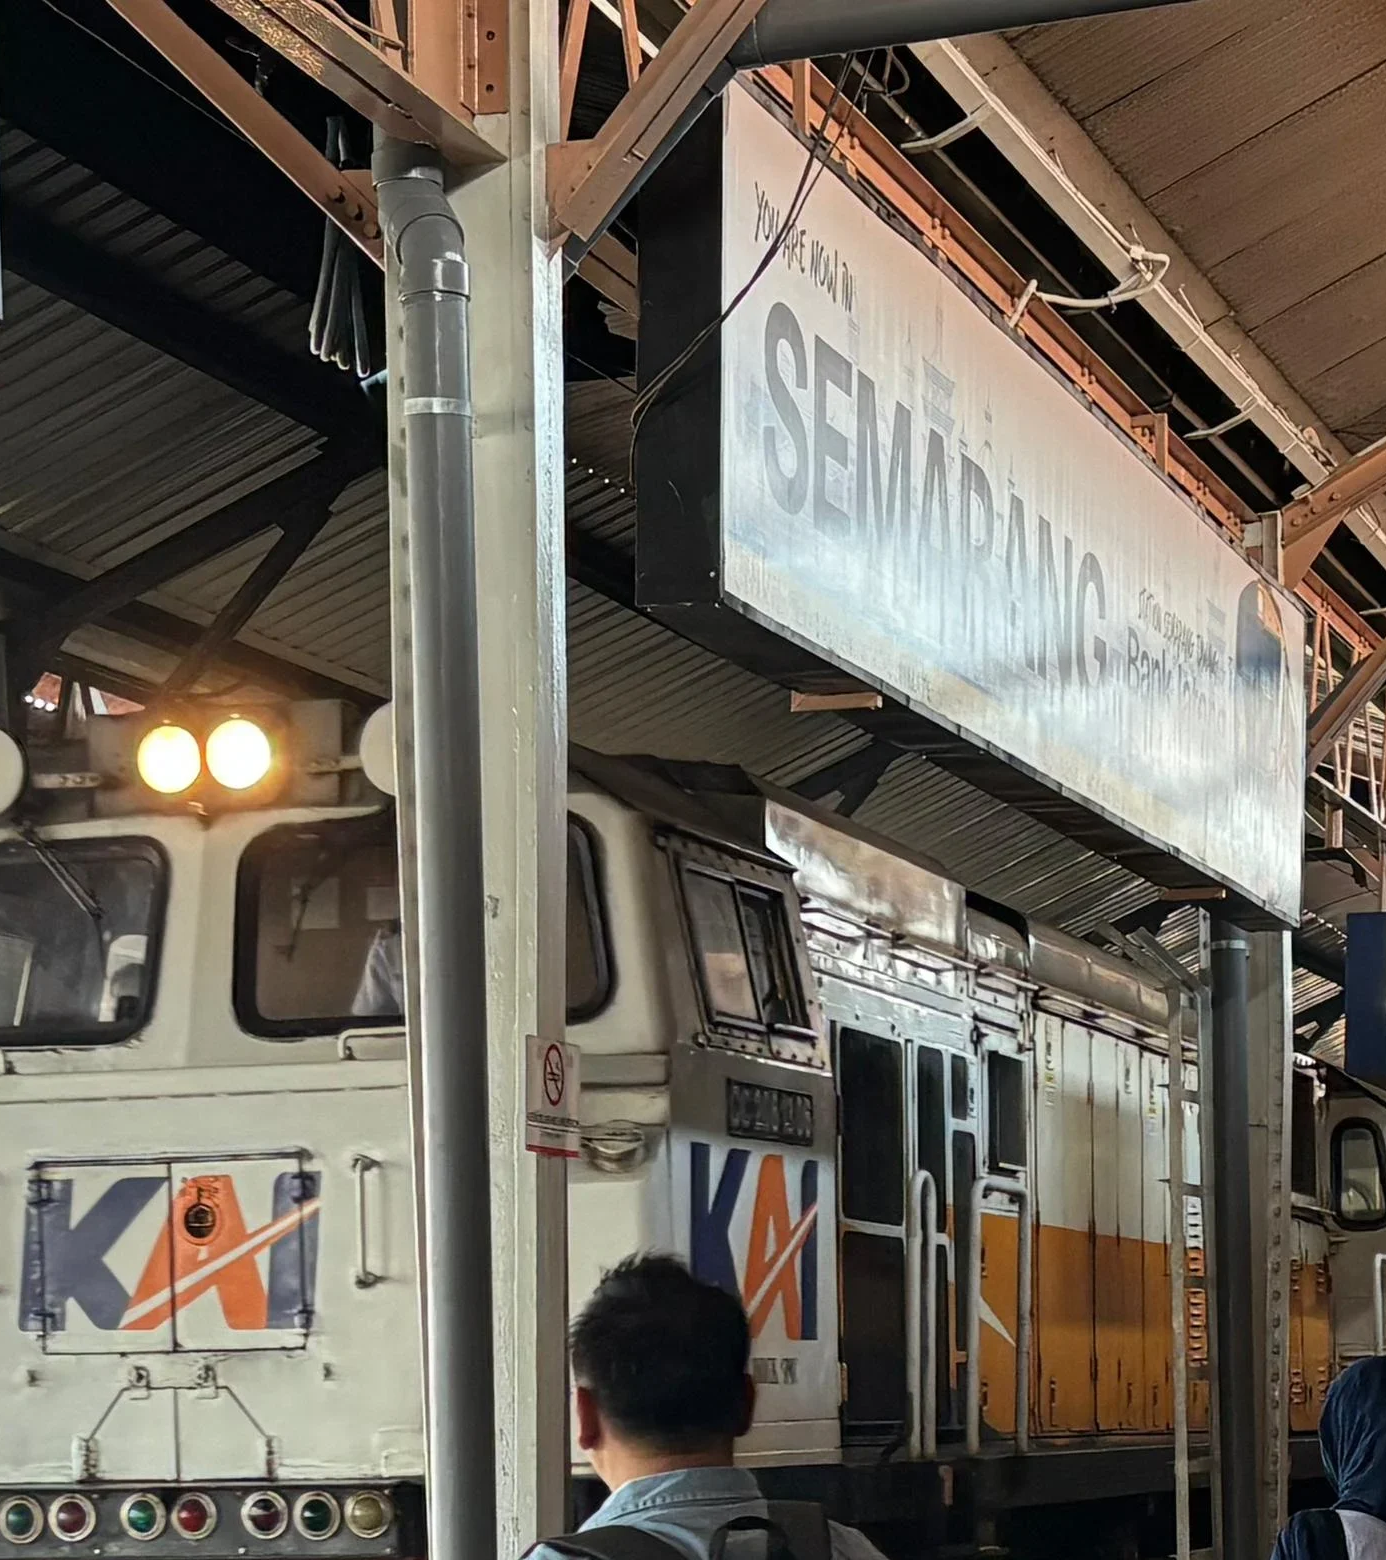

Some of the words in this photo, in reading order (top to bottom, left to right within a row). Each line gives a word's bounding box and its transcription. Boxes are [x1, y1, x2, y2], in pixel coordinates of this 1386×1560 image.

[755, 181, 780, 242] YOU
[783, 224, 806, 274] ARE
[810, 240, 838, 304] NOW
[763, 301, 1107, 692] SEMARANG
[1127, 626, 1173, 702] Bank
[18, 1170, 322, 1332] KAI
[691, 1141, 818, 1341] KAI
